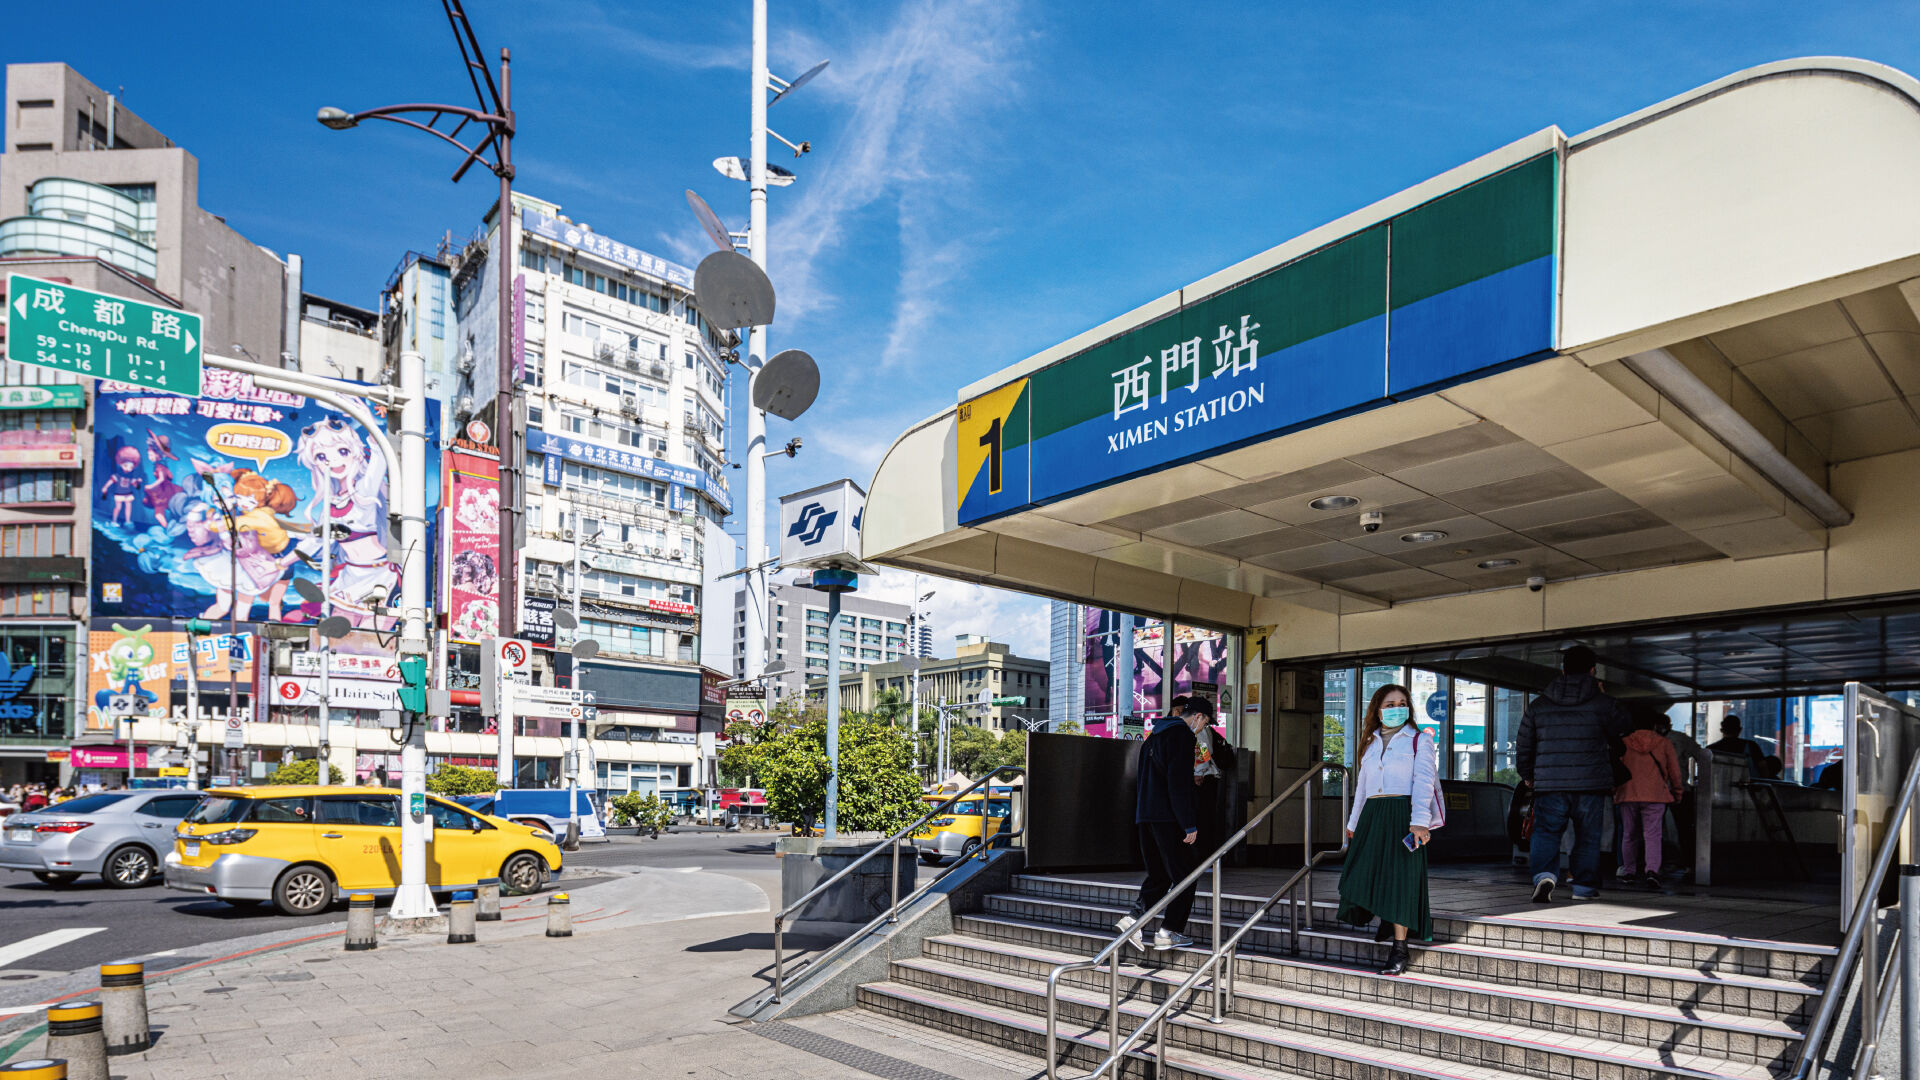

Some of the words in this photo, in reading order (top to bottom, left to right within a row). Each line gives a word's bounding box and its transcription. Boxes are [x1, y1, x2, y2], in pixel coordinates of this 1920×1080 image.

[32, 287, 181, 340] 成都路
[58, 320, 128, 344] ChengDu
[136, 336, 159, 351] Rd.
[1111, 315, 1261, 421] 西門站
[197, 400, 268, 422] 可愛出擊
[1107, 417, 1168, 455] XIMEN
[1173, 382, 1265, 432] STATION
[979, 416, 1002, 494] 1
[1256, 636, 1267, 664] 1
[335, 687, 370, 699] Hair
[172, 705, 251, 720] KLLER
